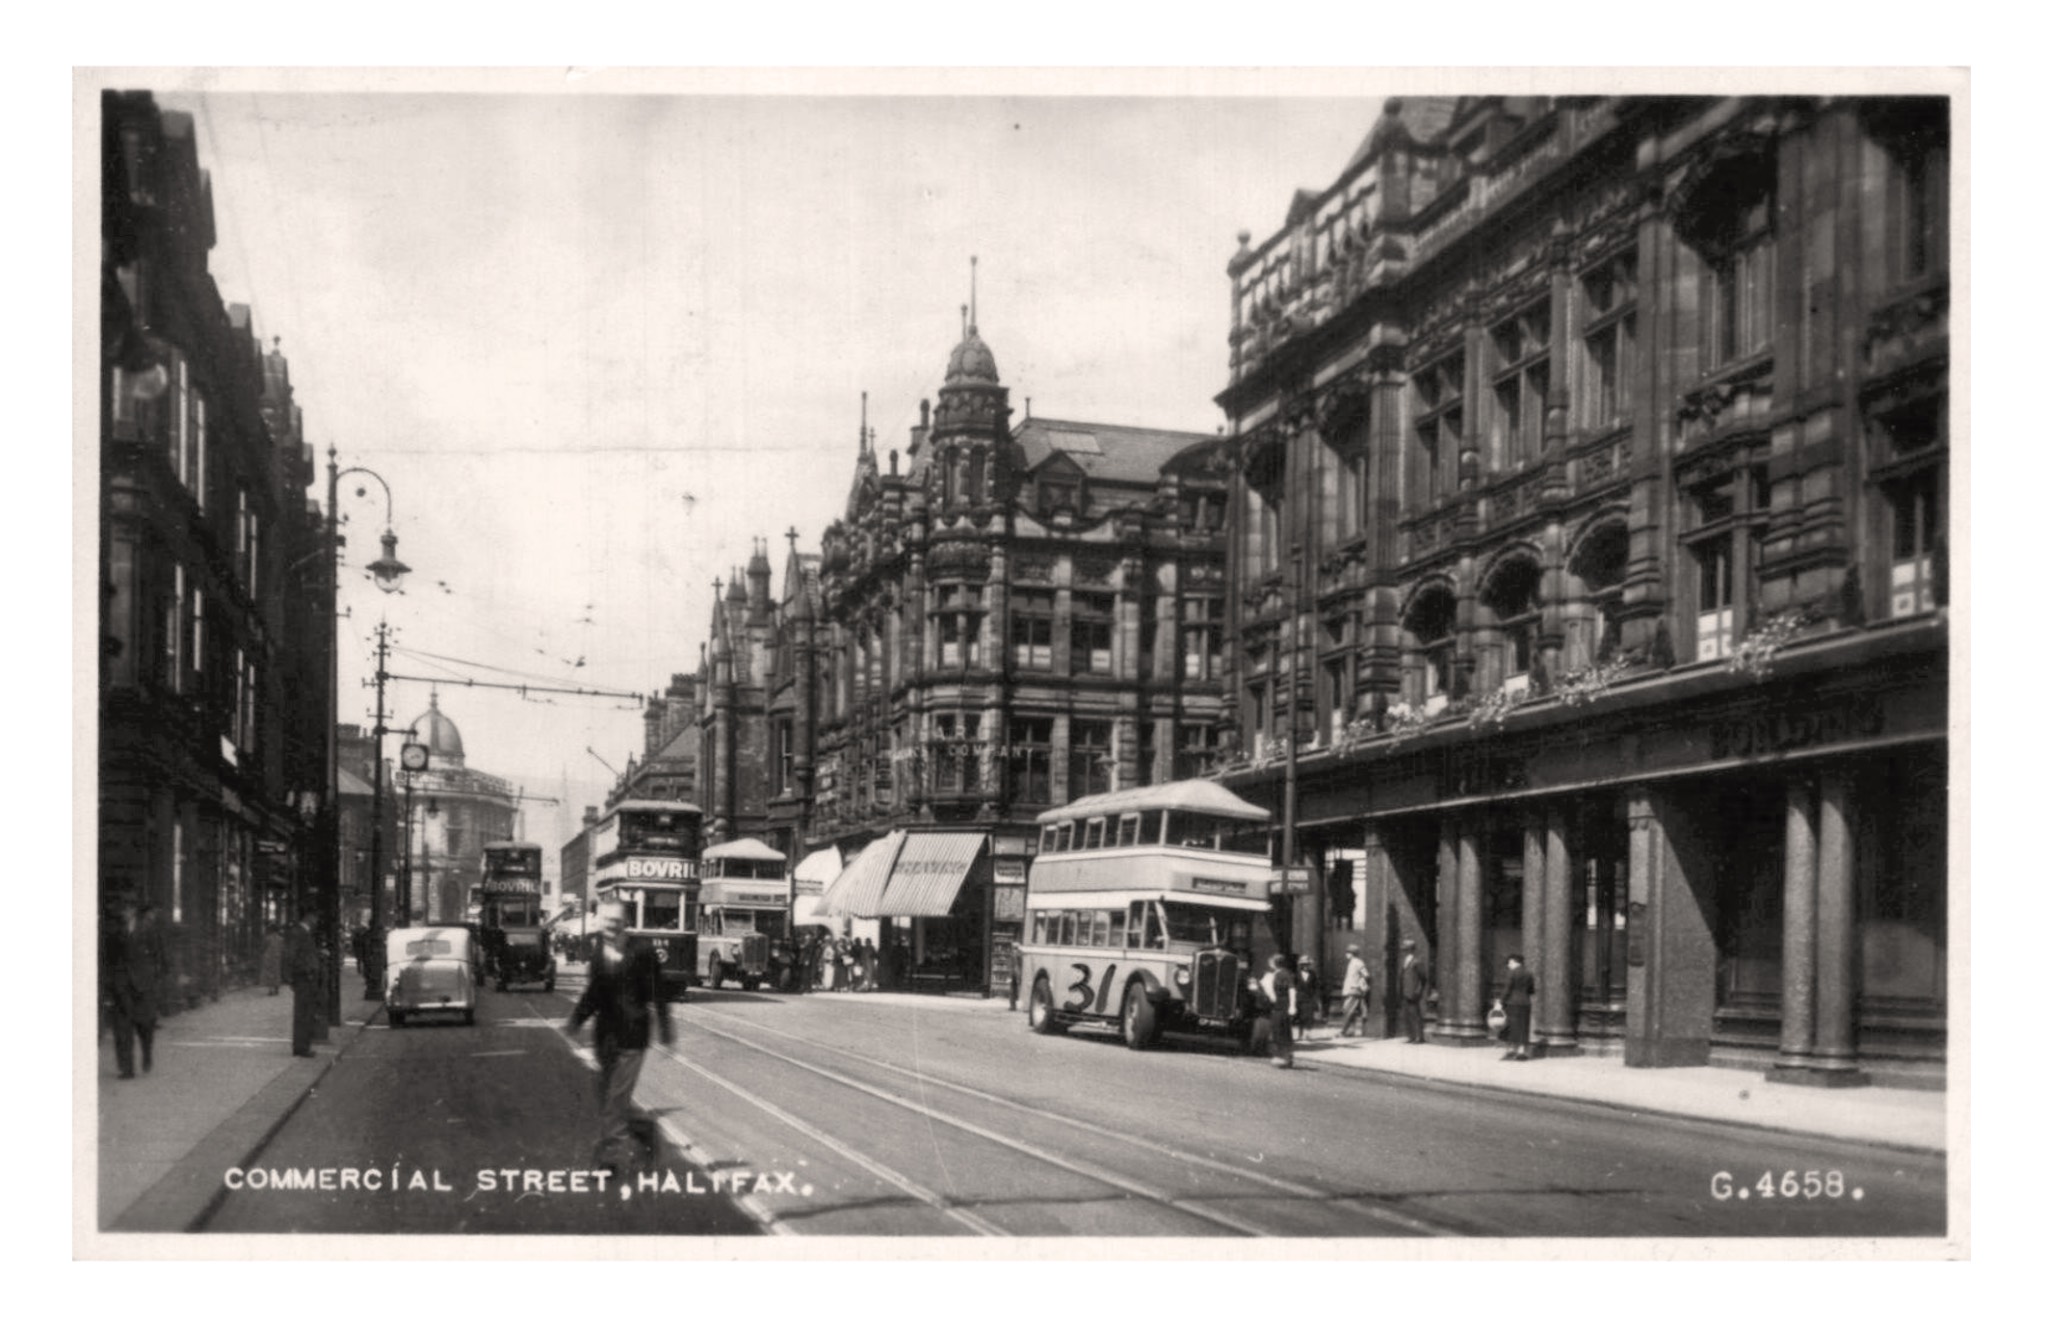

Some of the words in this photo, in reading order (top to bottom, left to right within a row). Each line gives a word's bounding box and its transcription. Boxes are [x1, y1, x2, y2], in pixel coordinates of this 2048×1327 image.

[629, 861, 697, 879] BOVRIL
[489, 880, 537, 893] BOVRIL
[1063, 962, 1117, 1014] 31
